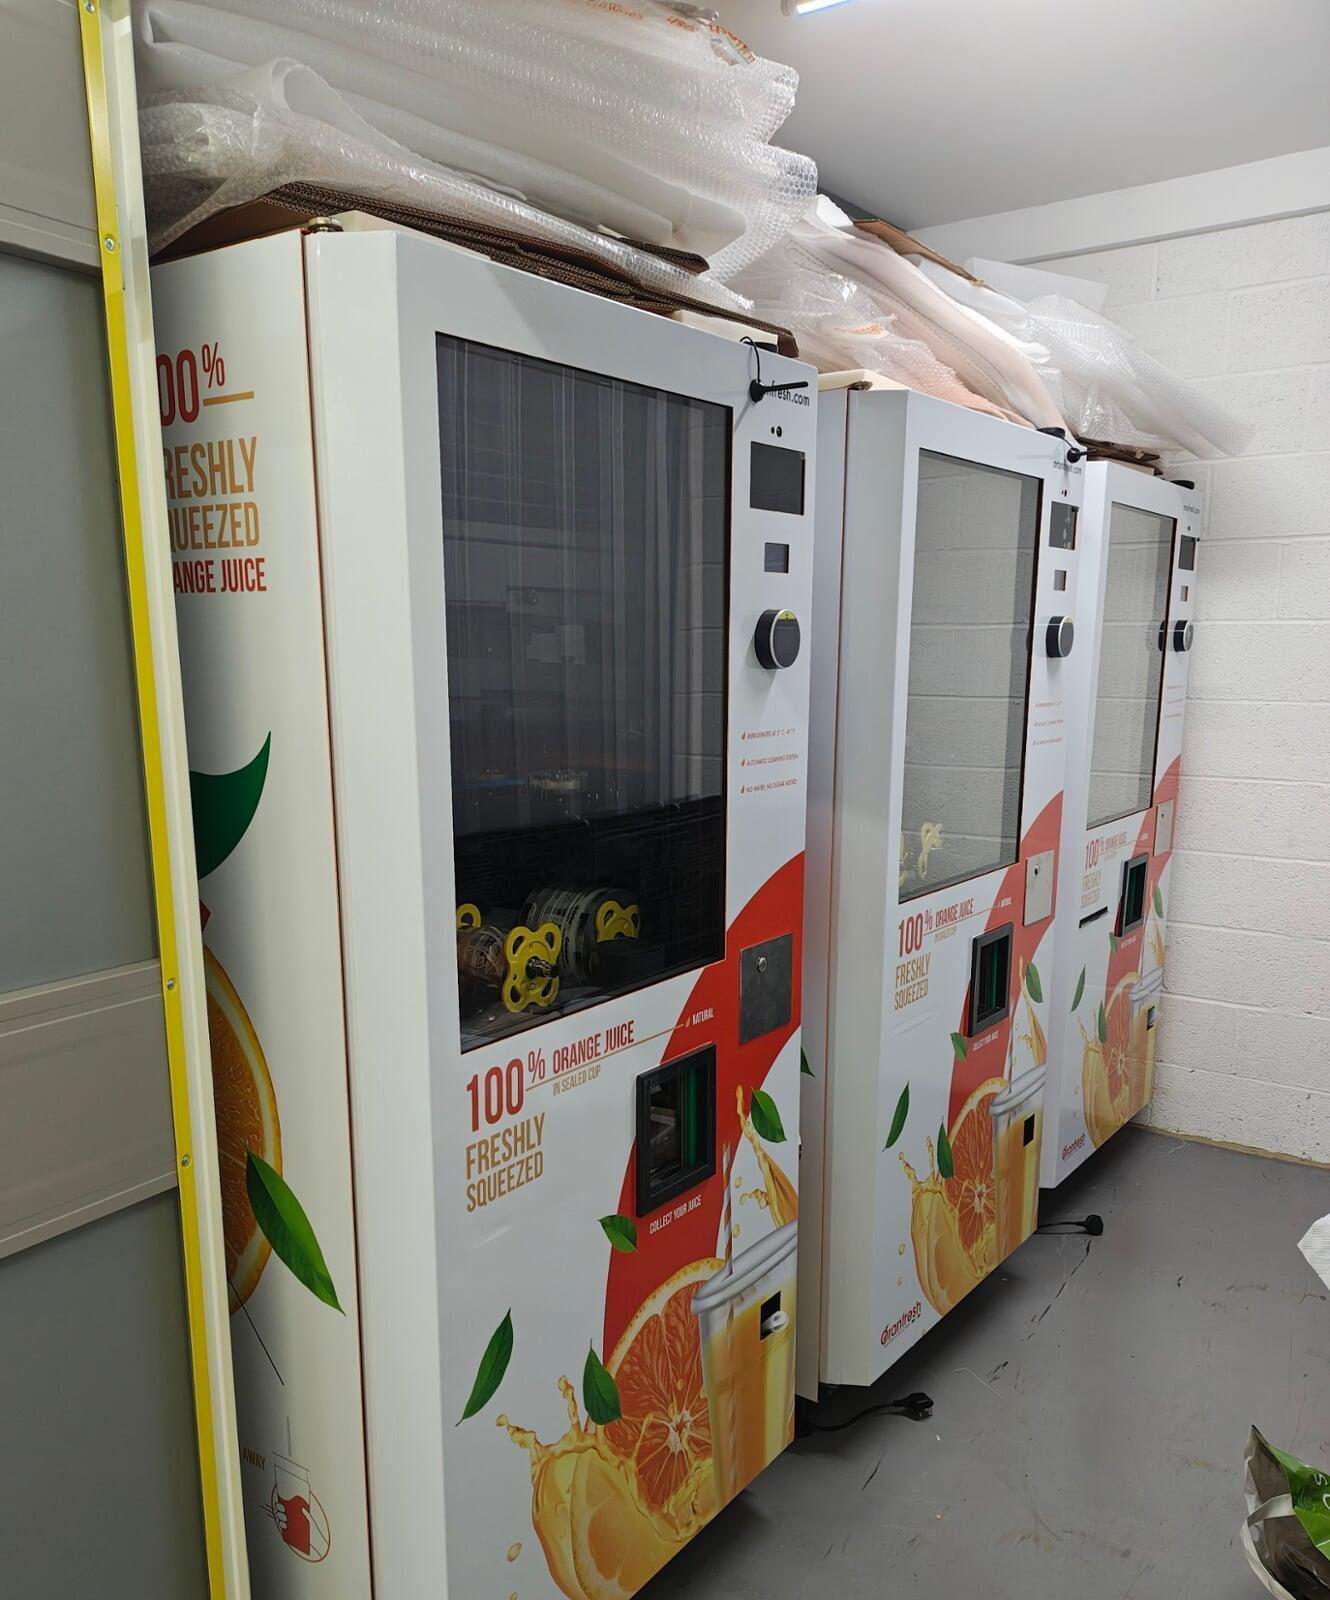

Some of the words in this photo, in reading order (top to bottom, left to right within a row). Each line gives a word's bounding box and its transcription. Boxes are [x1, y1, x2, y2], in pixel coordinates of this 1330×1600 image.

[220, 557, 268, 593] JUICE
[899, 907, 933, 958] 100%
[895, 951, 932, 989] FRESHLY
[466, 1048, 546, 1133] 100%
[552, 1033, 602, 1076] ORANGE
[603, 1020, 636, 1055] JUICE
[552, 1081, 562, 1097] IN
[561, 1070, 588, 1093] SEALED
[587, 1064, 602, 1081] CUP
[465, 1111, 546, 1181] FRESHLY
[466, 1150, 544, 1214] SQUEEZED
[649, 1210, 673, 1235] COLLECT
[673, 1202, 688, 1221] YOUR
[687, 1194, 702, 1213] JUICE
[242, 1448, 265, 1471] AWAY
